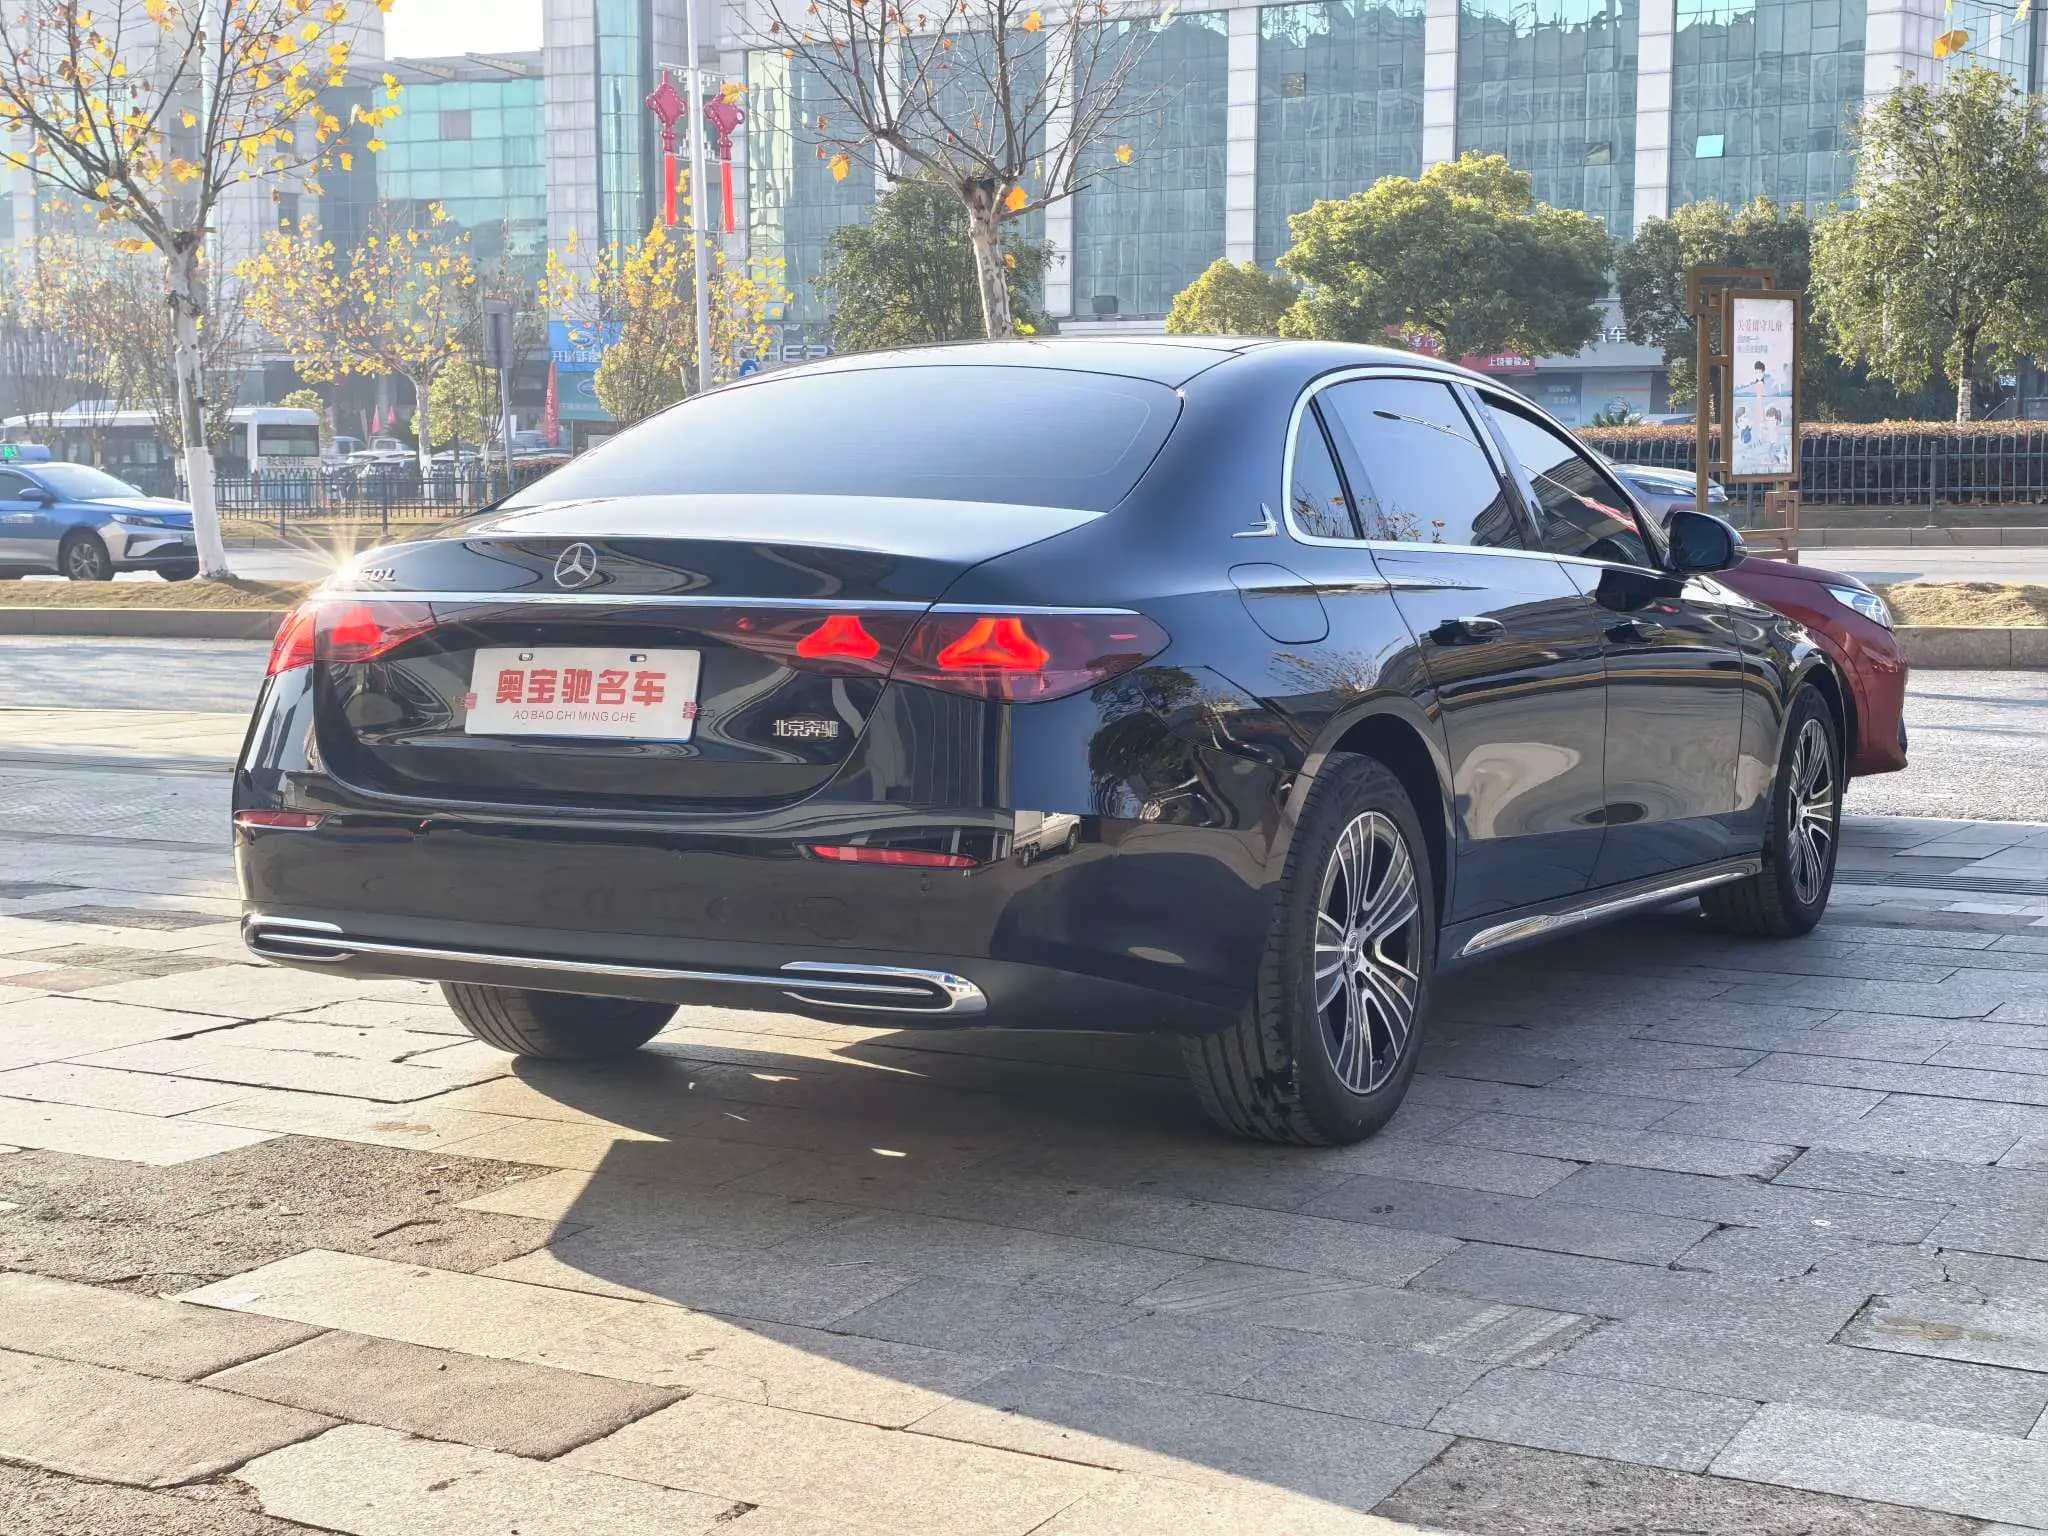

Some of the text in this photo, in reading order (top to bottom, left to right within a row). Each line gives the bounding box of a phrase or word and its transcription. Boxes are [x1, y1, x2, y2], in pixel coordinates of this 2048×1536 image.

[496, 669, 666, 706] 奥宝驰名车
[512, 710, 638, 723] AO BAO CHI MING CHE
[769, 719, 839, 738] 北京奔驰
